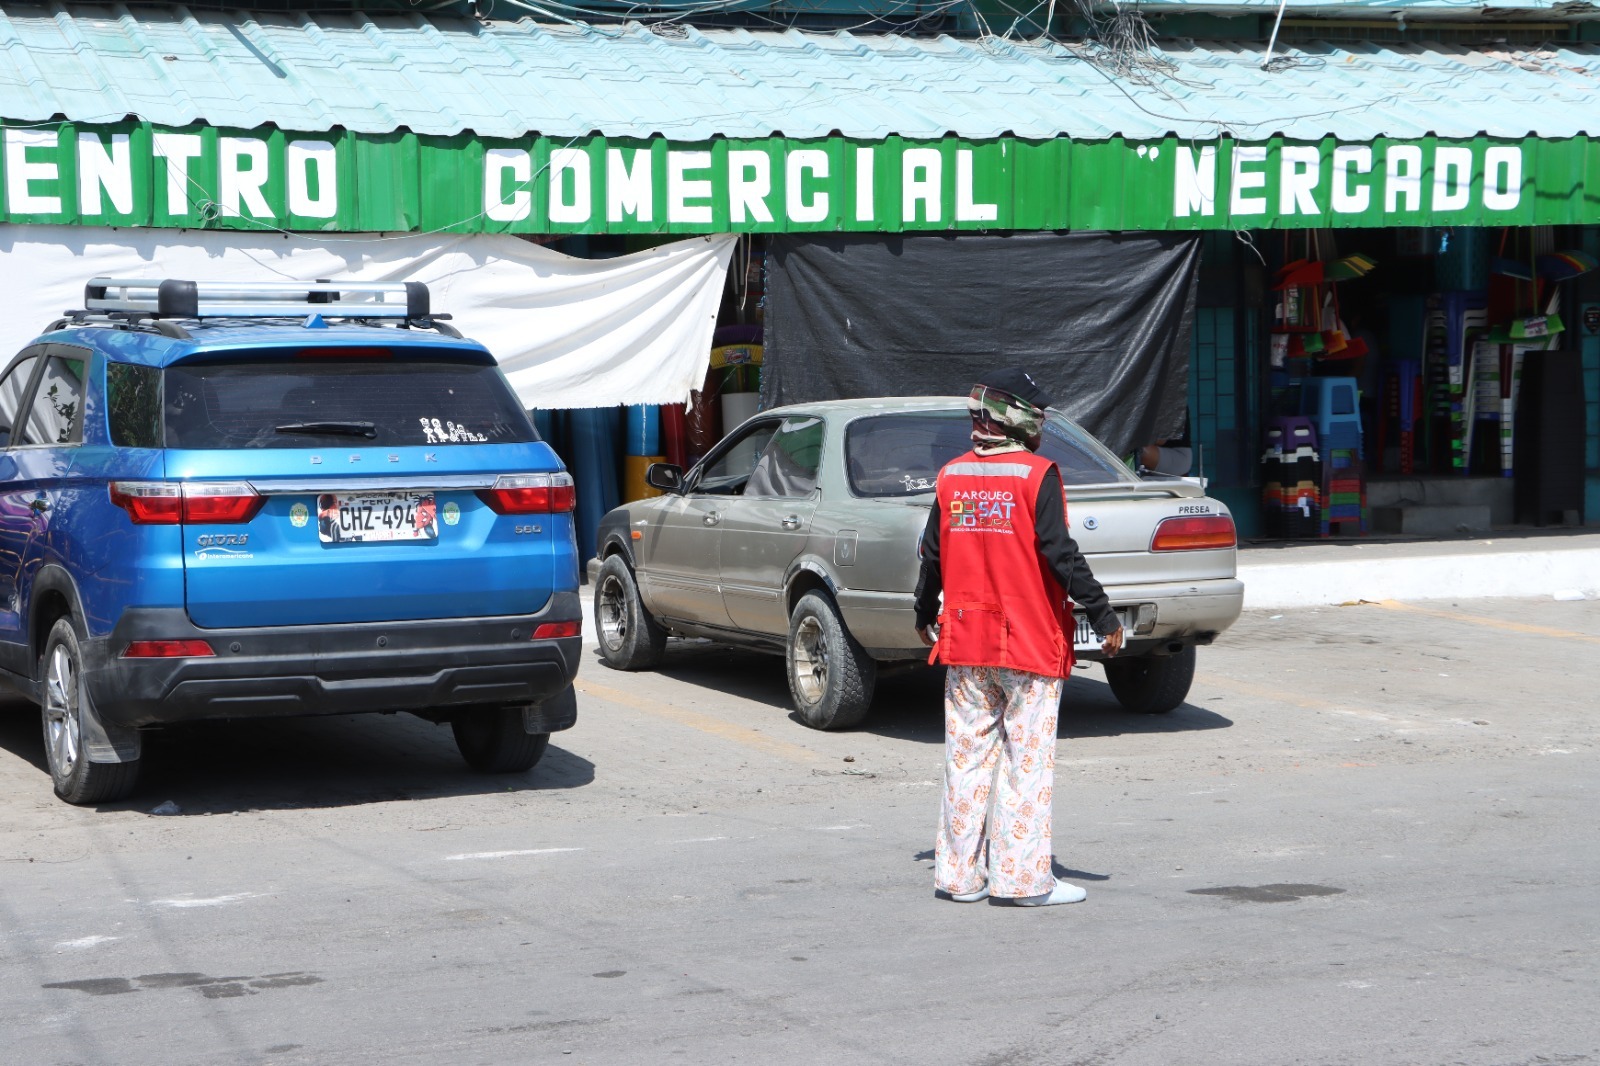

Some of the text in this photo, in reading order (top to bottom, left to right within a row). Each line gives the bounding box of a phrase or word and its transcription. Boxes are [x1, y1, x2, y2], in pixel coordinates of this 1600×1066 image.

[1, 128, 338, 219] ENTRO
[483, 147, 998, 224] COMERCIAL
[310, 453, 437, 464] DFSK
[953, 490, 1013, 501] PARQUEO
[978, 501, 1016, 519] SAT
[1178, 505, 1210, 514] PRESEA
[340, 504, 416, 531] CHZ-494
